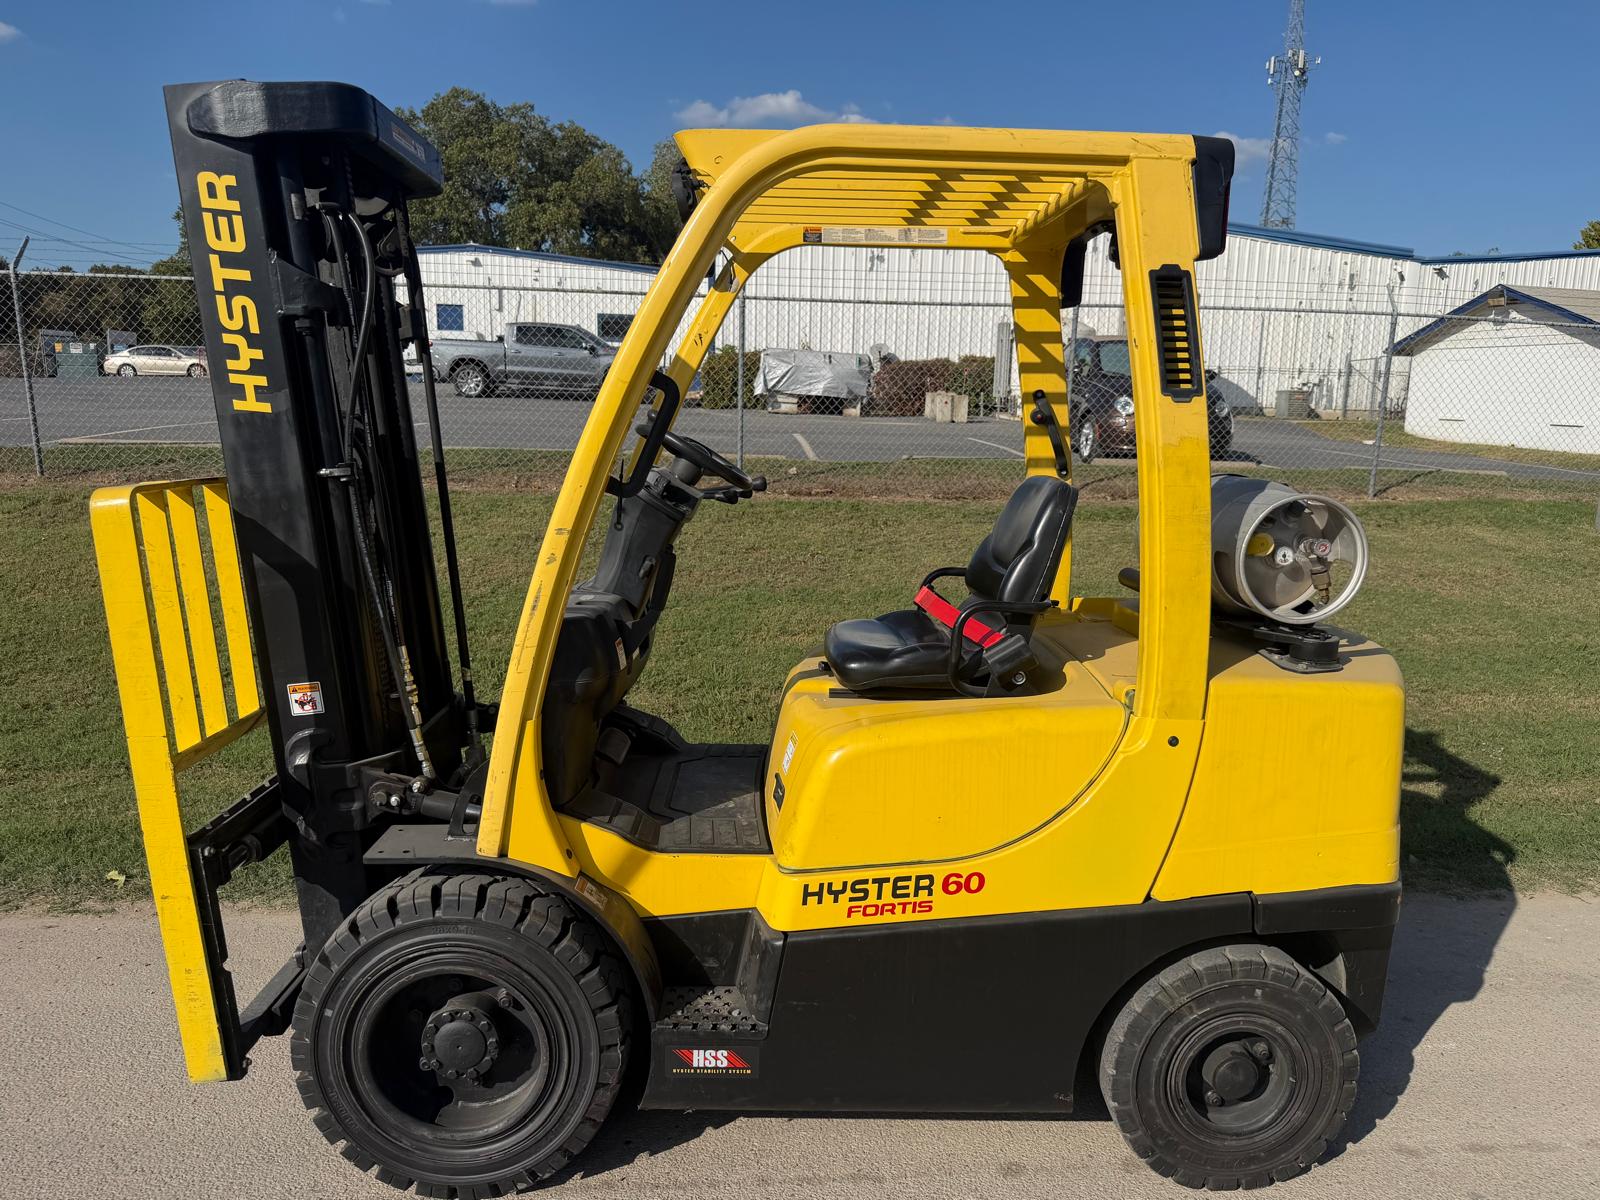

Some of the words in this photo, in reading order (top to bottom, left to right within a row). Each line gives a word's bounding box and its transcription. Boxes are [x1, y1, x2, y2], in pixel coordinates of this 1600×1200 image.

[197, 171, 273, 414] HYSTER
[801, 874, 935, 906] HYSTER
[941, 871, 986, 896] 60
[846, 900, 934, 919] FORTIS
[692, 1049, 728, 1068] HSS
